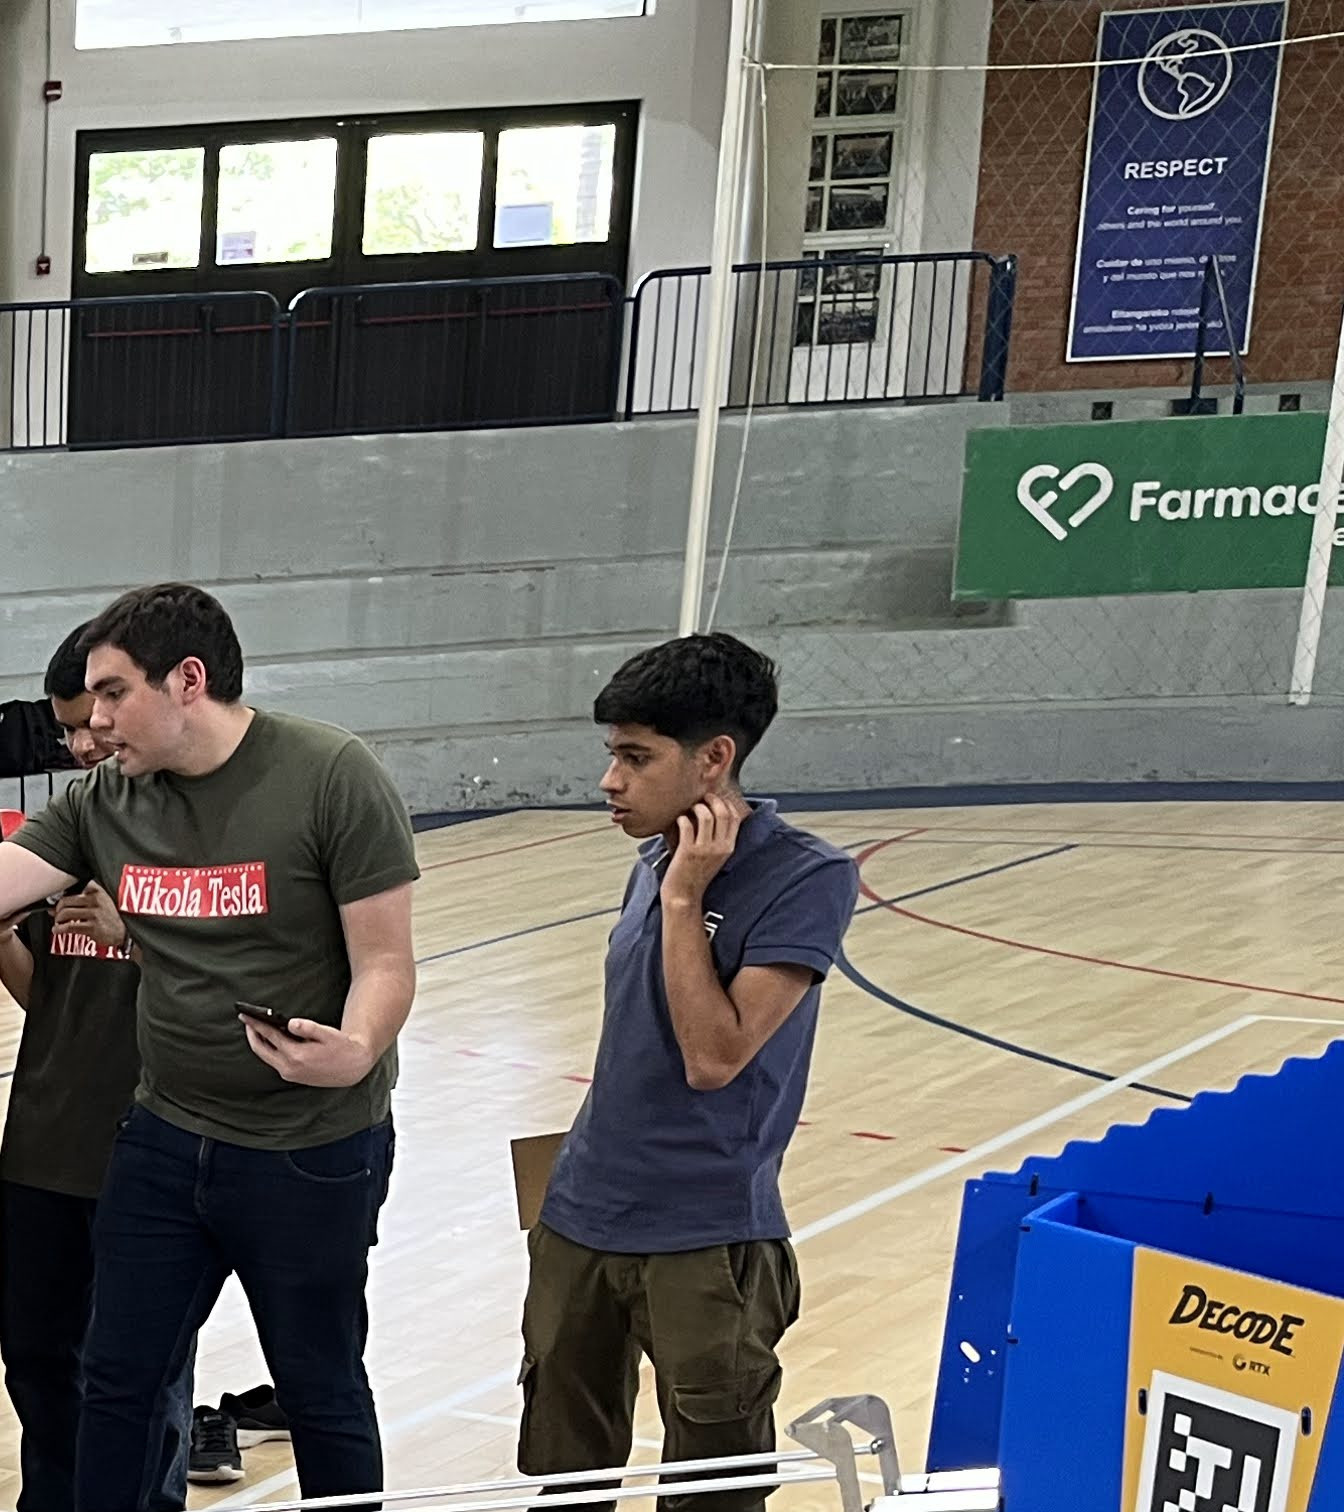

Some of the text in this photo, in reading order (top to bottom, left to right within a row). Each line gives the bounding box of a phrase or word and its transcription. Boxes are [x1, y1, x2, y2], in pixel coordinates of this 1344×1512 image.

[1124, 157, 1228, 179] RESPECT
[1130, 481, 1344, 522] Farmac
[120, 871, 264, 918] Nikola Tesla
[1168, 1284, 1305, 1356] DECODE
[1249, 1361, 1270, 1376] RTX
